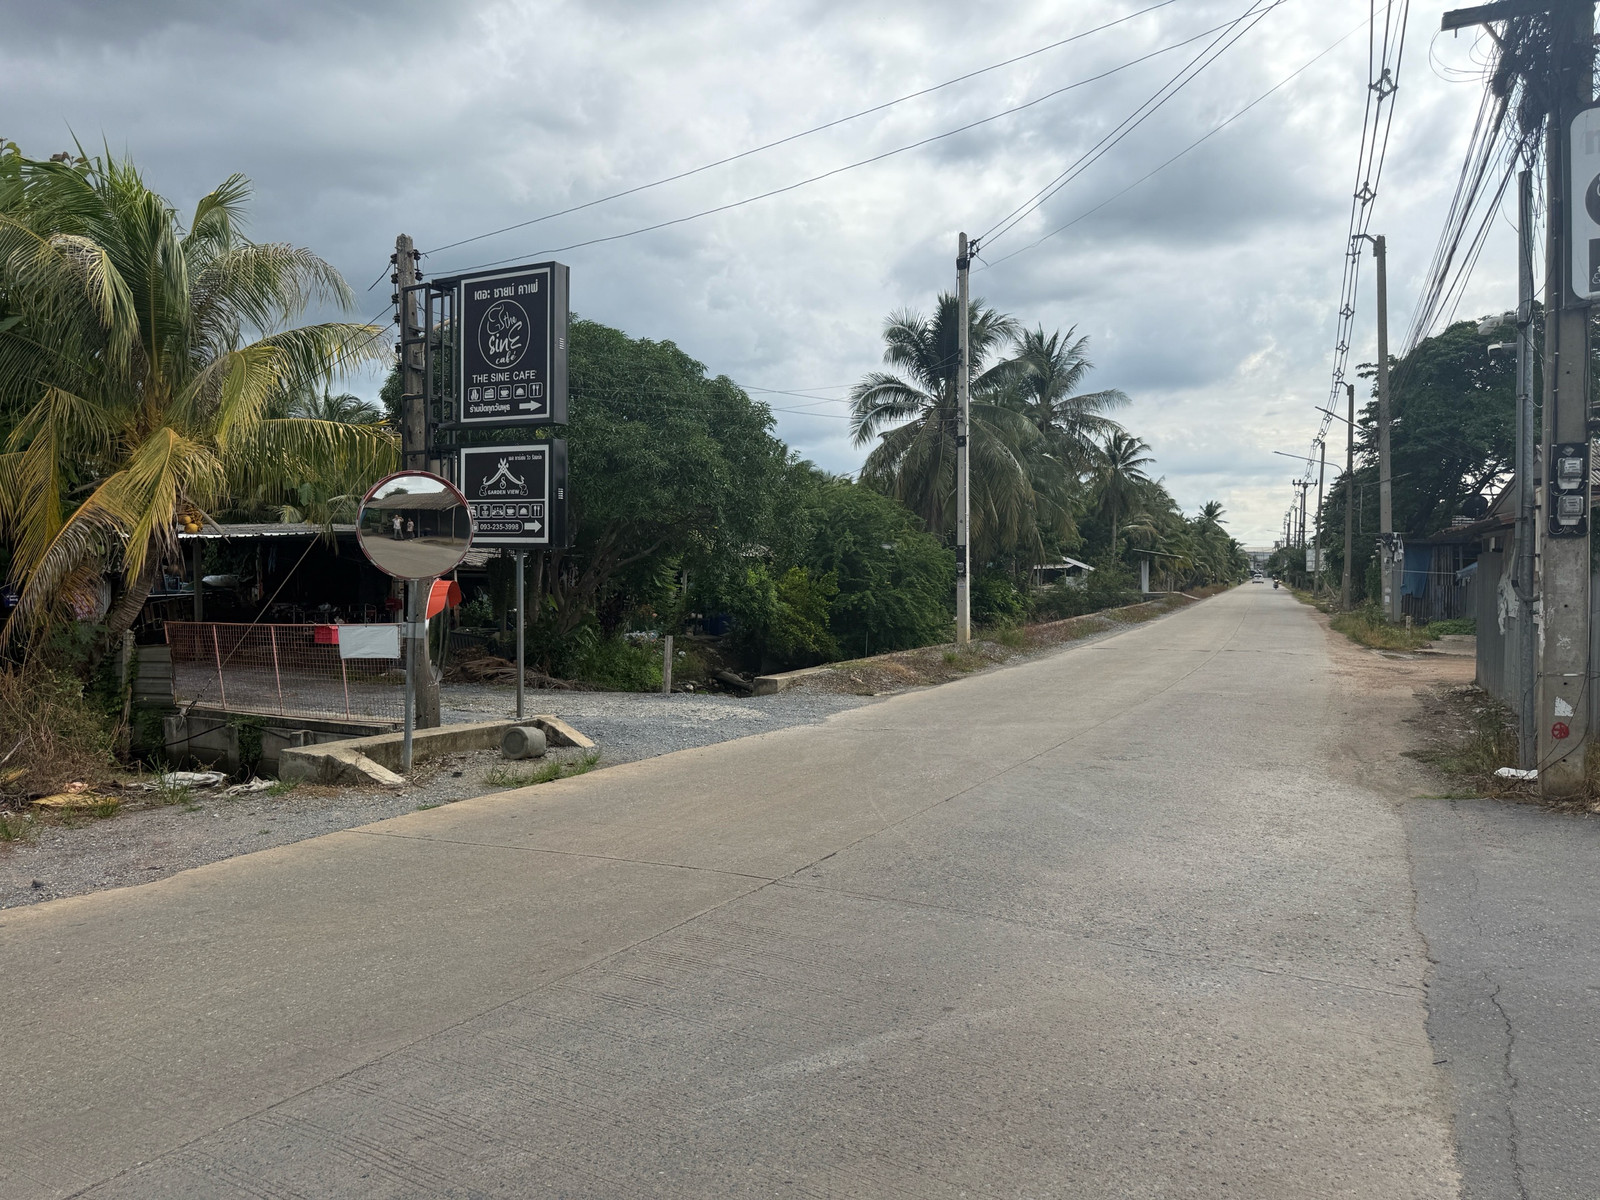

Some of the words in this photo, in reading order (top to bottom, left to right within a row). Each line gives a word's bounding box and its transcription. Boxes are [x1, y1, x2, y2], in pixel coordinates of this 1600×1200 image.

[474, 290, 490, 300] เดอะ
[472, 374, 489, 383] THE
[491, 372, 510, 382] SINE
[513, 370, 536, 380] CAFE
